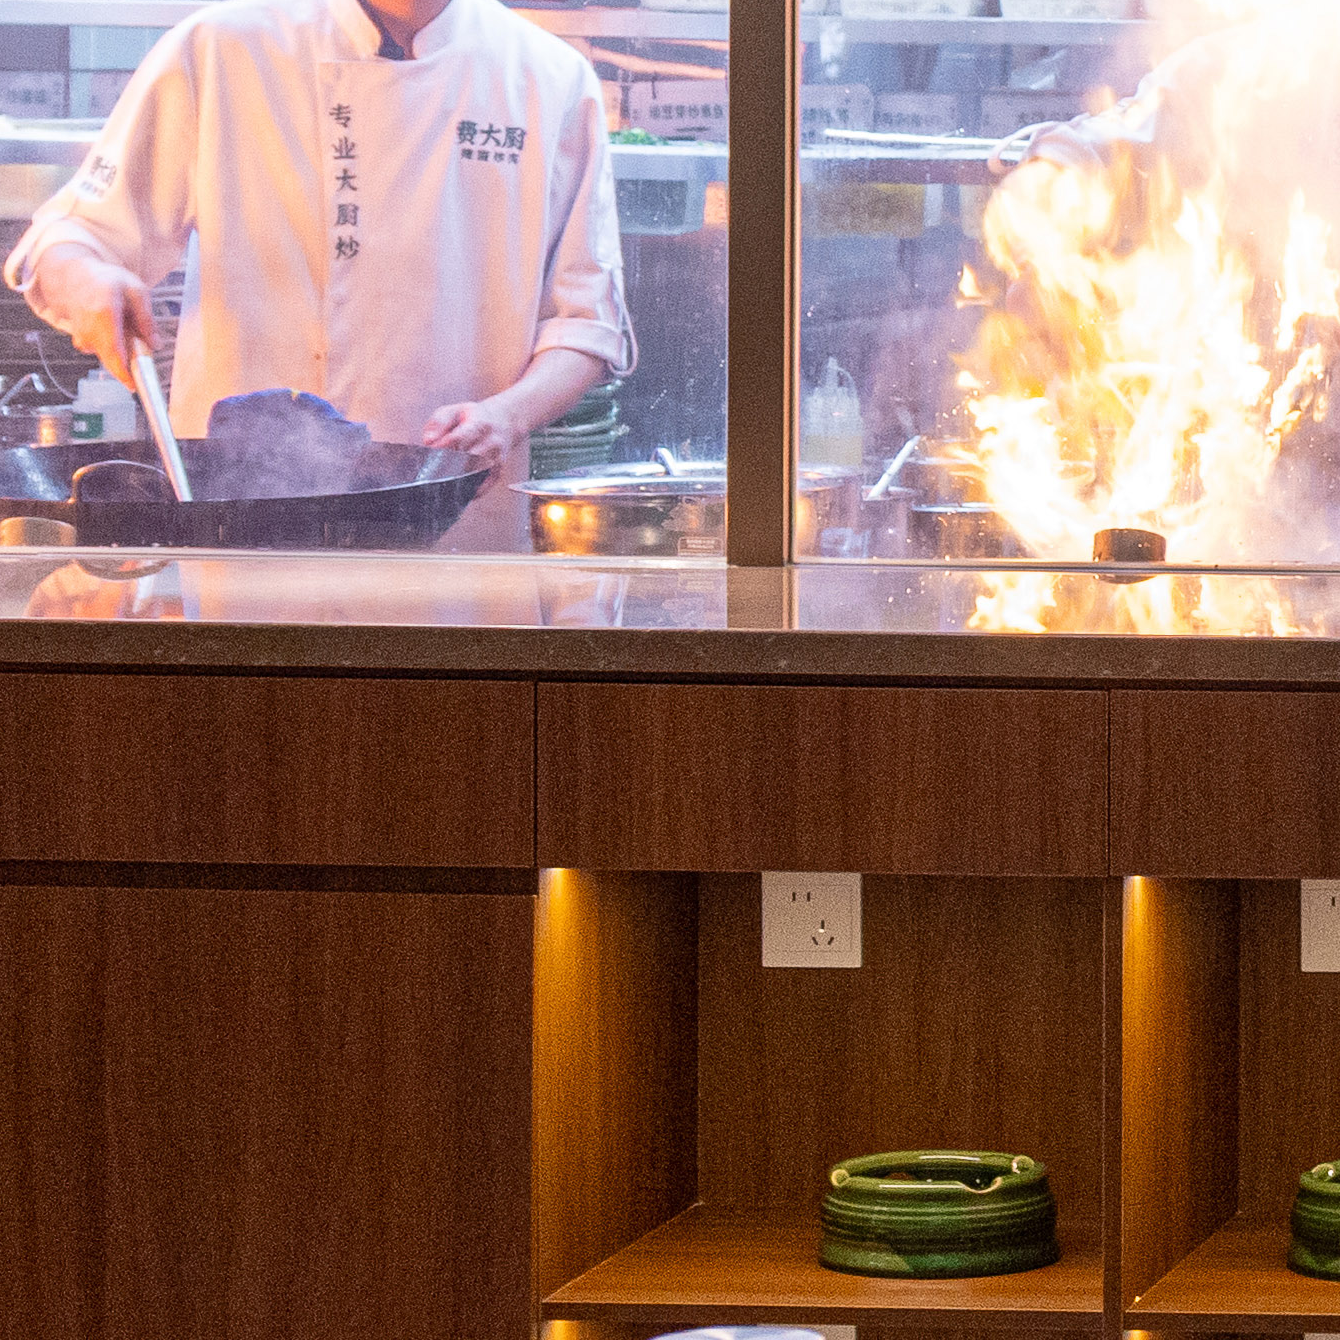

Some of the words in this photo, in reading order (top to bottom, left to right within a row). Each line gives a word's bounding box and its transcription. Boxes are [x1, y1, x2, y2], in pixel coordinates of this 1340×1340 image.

[329, 103, 360, 260] 专业大厨炒
[456, 120, 526, 150] 费大厨
